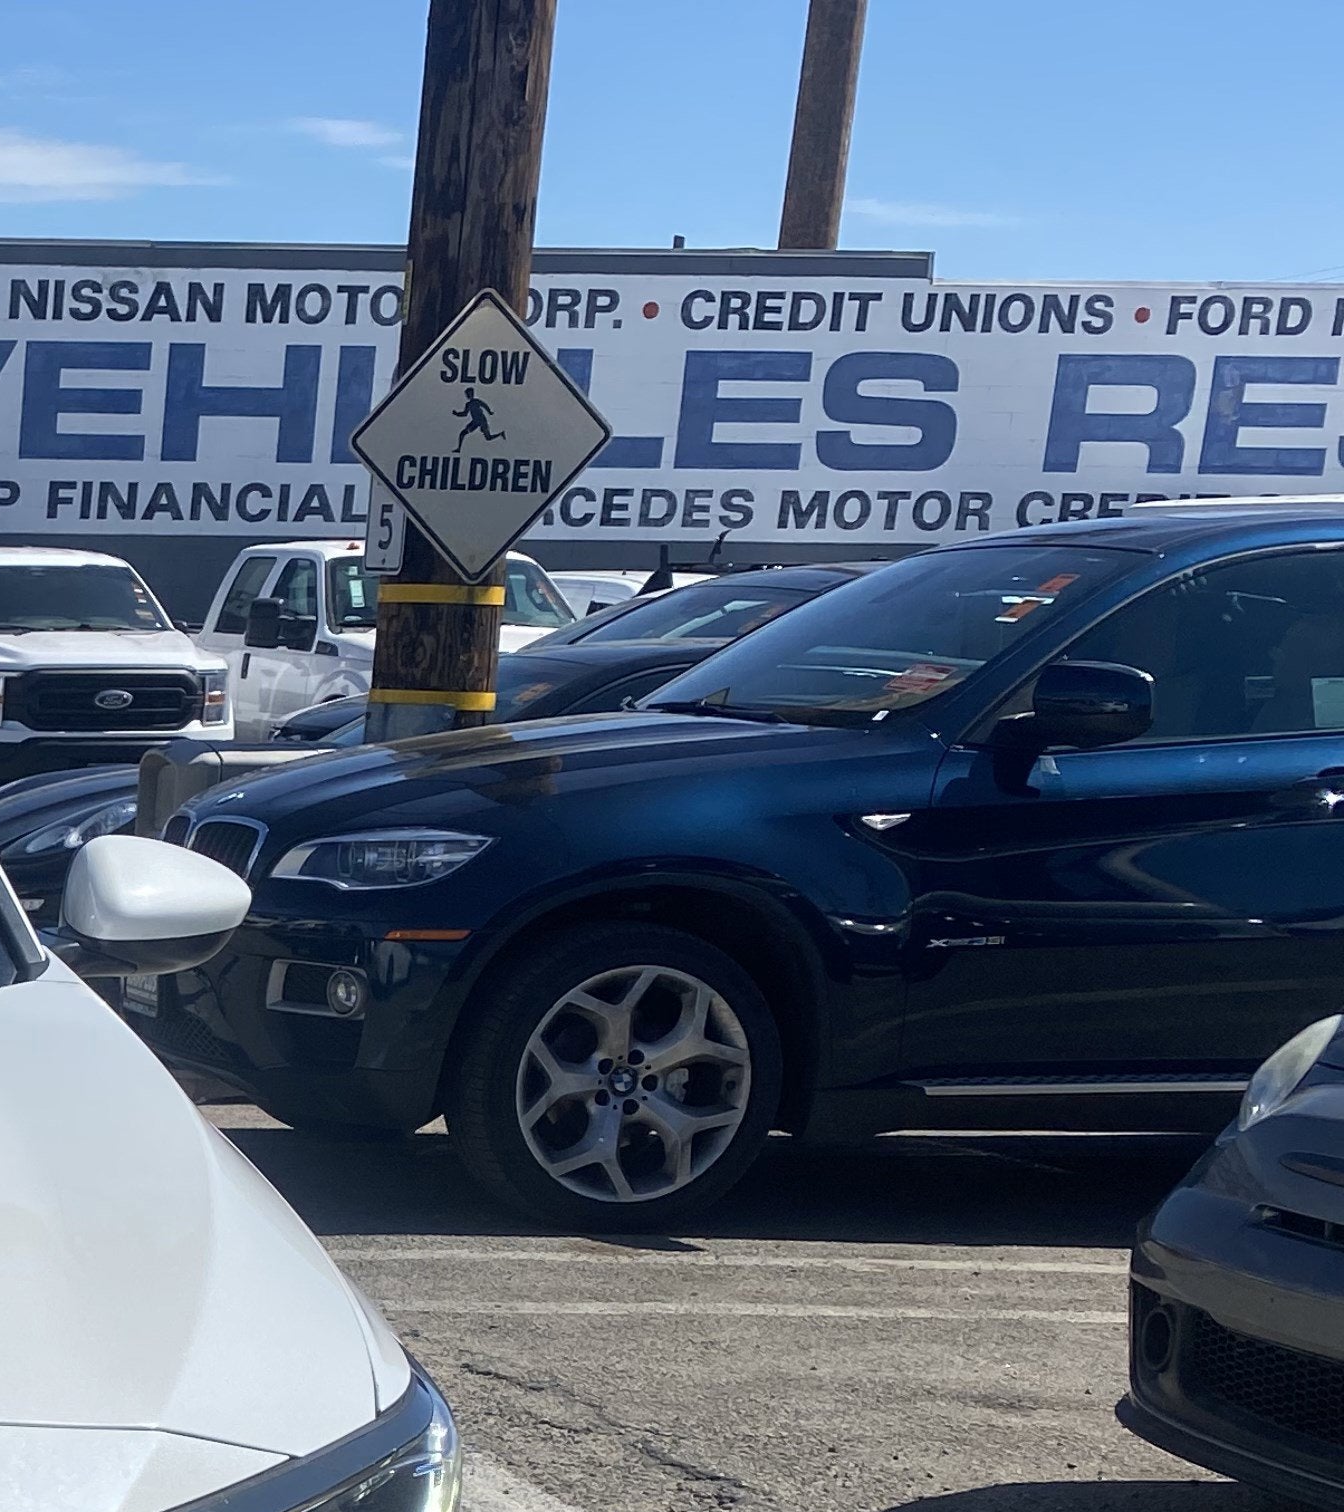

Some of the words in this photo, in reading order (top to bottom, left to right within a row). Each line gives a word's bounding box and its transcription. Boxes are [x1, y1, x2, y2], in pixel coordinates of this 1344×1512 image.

[8, 279, 225, 325] NISSAN
[244, 283, 405, 327] MOTO
[680, 290, 884, 333] CREDIT
[900, 293, 1115, 336] UNIONS
[1165, 296, 1313, 337] FORD
[440, 348, 530, 386] SLOW
[1042, 353, 1344, 477] RE
[396, 455, 552, 493] CHILDREN
[46, 480, 367, 524] FINANCIAL
[543, 487, 755, 531] CEDES
[777, 490, 994, 532] MOTOR
[378, 504, 394, 550] 5
